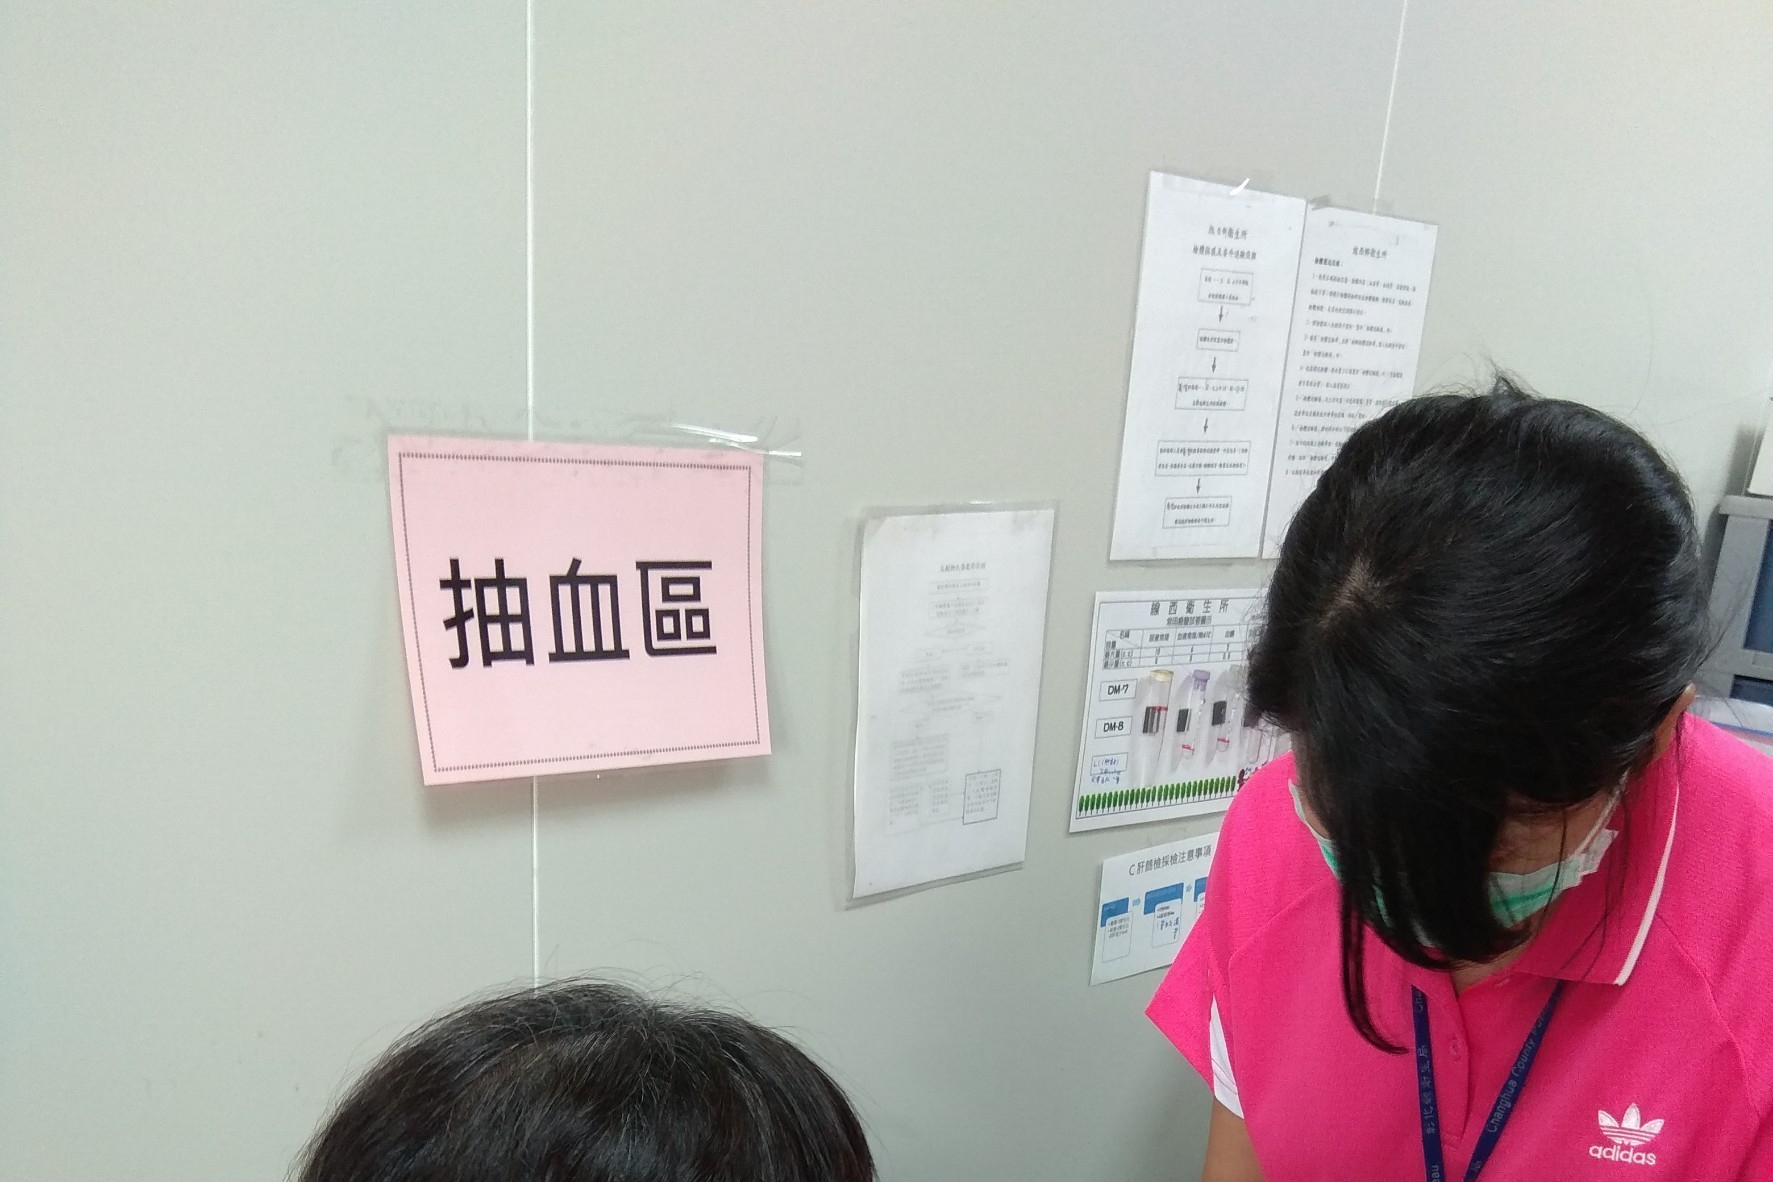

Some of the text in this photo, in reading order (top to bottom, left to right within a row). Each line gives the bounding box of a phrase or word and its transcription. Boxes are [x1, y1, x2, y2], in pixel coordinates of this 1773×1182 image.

[439, 557, 718, 669] 抽血區
[1107, 684, 1129, 695] DM-7
[1103, 721, 1124, 732] DM-8
[1589, 1145, 1657, 1166] adidas
